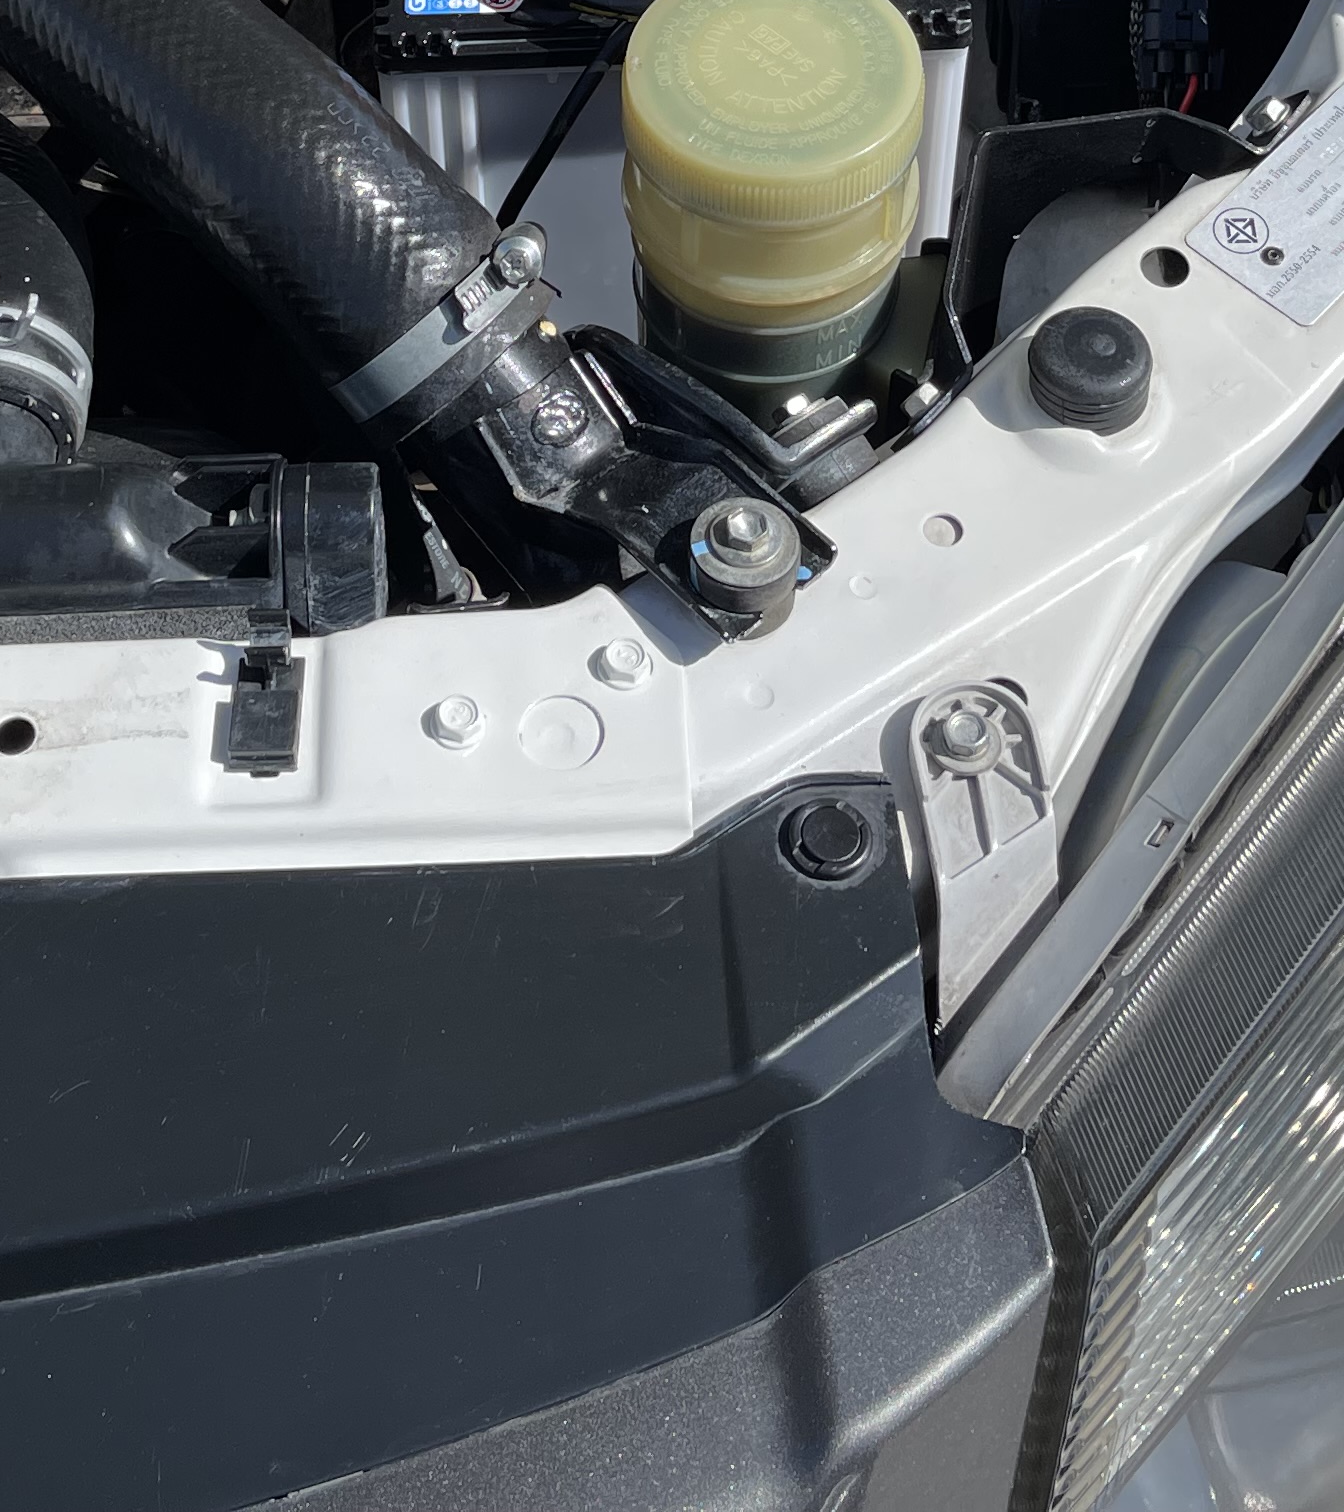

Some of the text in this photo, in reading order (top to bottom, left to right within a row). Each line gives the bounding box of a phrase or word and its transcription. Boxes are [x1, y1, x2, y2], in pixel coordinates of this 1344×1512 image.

[697, 10, 745, 86] CAUTION
[724, 69, 848, 114] ATTENTION
[709, 107, 789, 134] EMPLOYER
[817, 310, 863, 345] MAX
[815, 333, 862, 370] MIN
